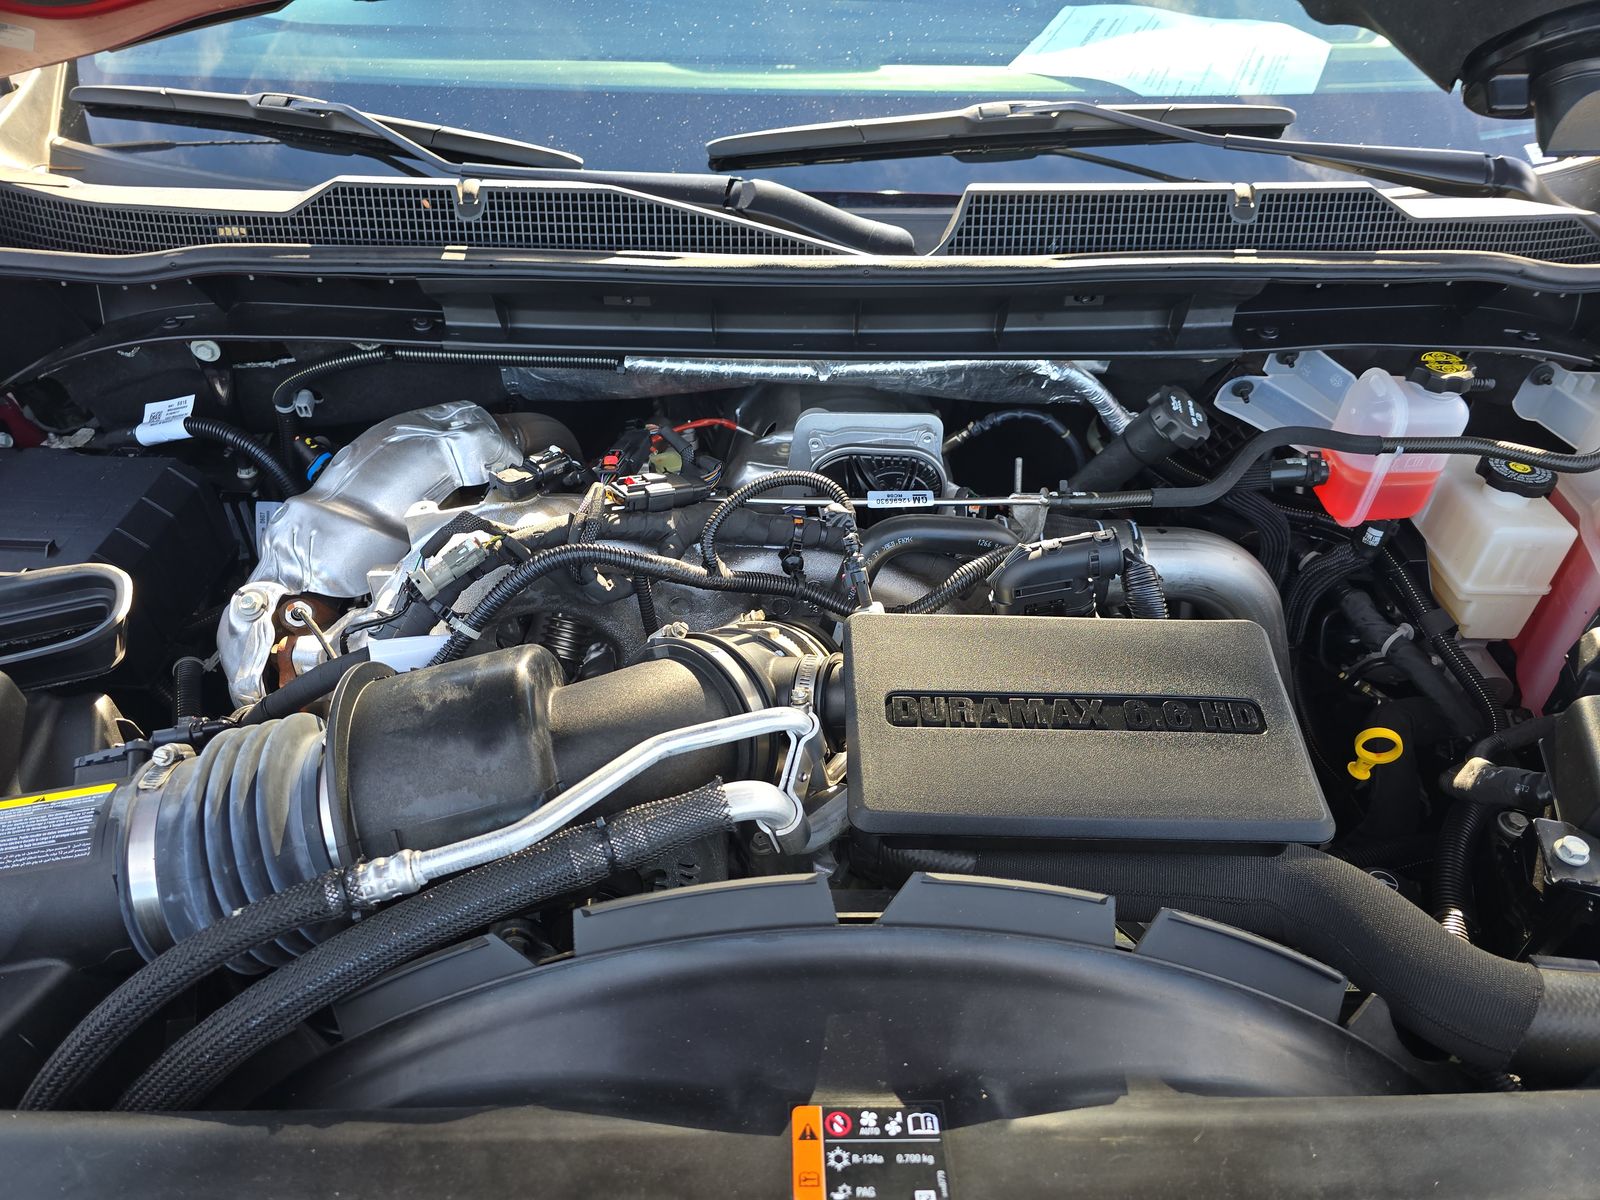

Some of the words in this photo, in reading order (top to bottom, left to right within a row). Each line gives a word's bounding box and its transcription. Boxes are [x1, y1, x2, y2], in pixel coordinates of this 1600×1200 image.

[912, 496, 928, 504] GM
[891, 695, 1109, 729] DURAMAX
[1123, 699, 1193, 730] 6.6
[1199, 701, 1260, 732] HD
[859, 1127, 881, 1136] AUTO
[851, 1153, 885, 1165] R-134a
[921, 1153, 935, 1166] kg
[855, 1186, 877, 1198] PAG
